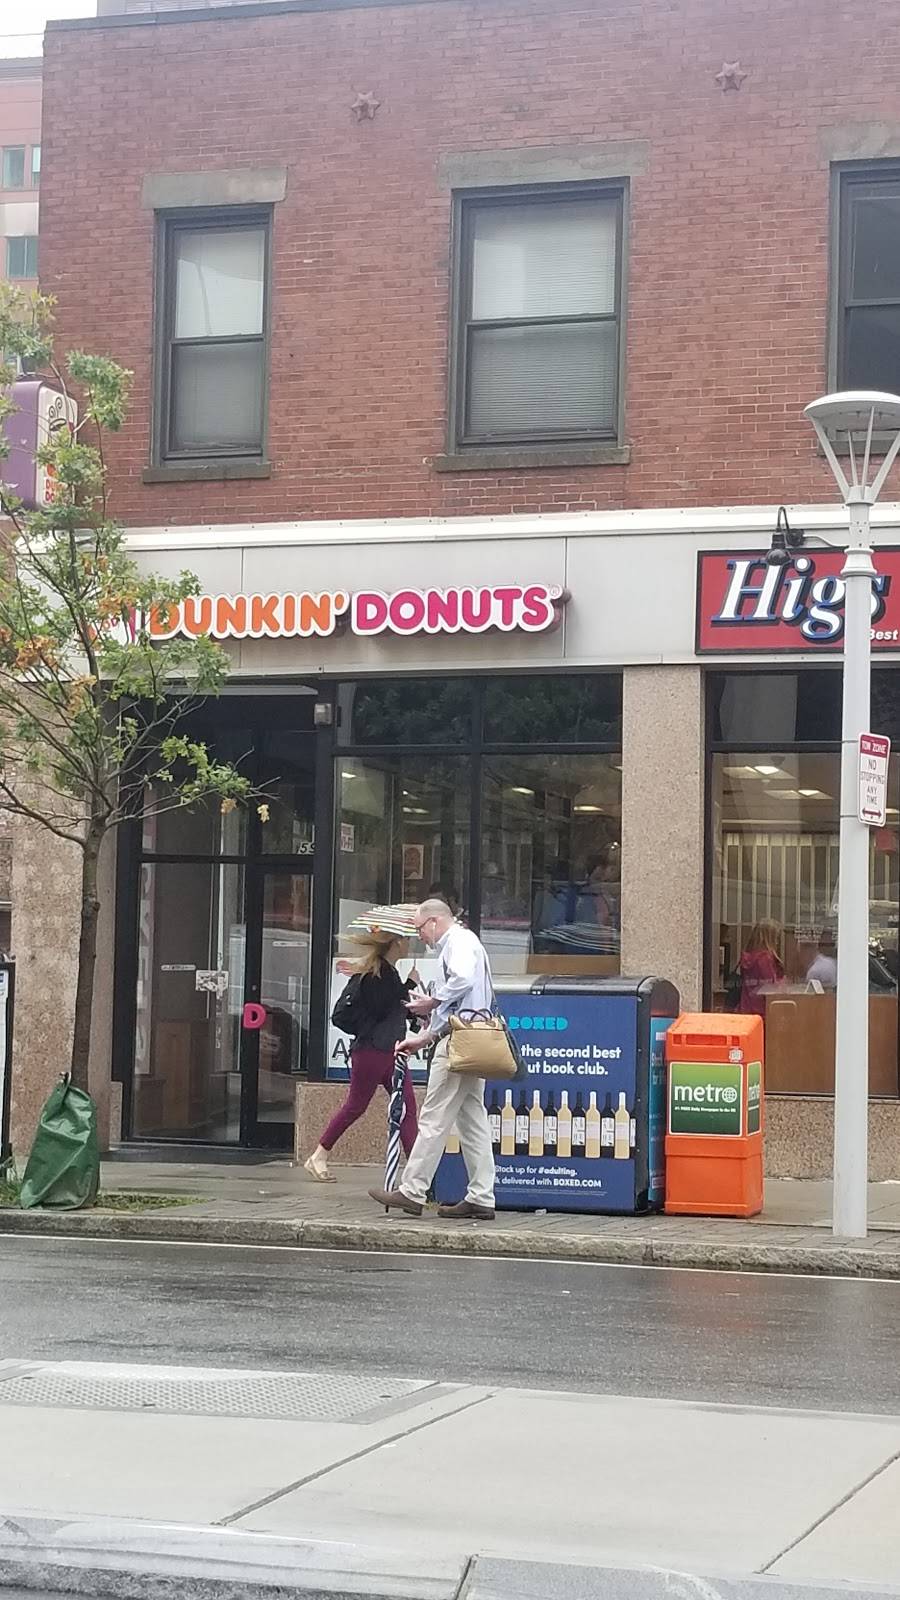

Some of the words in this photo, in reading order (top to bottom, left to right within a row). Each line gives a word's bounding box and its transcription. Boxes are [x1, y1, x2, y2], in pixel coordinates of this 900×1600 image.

[149, 593, 345, 636] DUNKIN'
[356, 586, 549, 631] DONUTS
[872, 743, 887, 754] ZONE
[867, 760, 877, 770] NO
[860, 771, 885, 785] STOPPING
[866, 785, 878, 795] ANY
[866, 795, 878, 806] TIME
[243, 1003, 267, 1029] D
[508, 1016, 569, 1031] BOXED
[520, 1043, 542, 1058] the
[544, 1045, 591, 1059] second
[592, 1045, 622, 1059] best
[527, 1062, 541, 1074] ut
[542, 1060, 575, 1075] book
[576, 1062, 609, 1075] club.
[674, 1083, 738, 1104] metro
[515, 1167, 526, 1176] up
[526, 1165, 537, 1174] for
[501, 1177, 536, 1186] delivered
[536, 1177, 553, 1186] with
[553, 1179, 602, 1188] BOXED.COM
